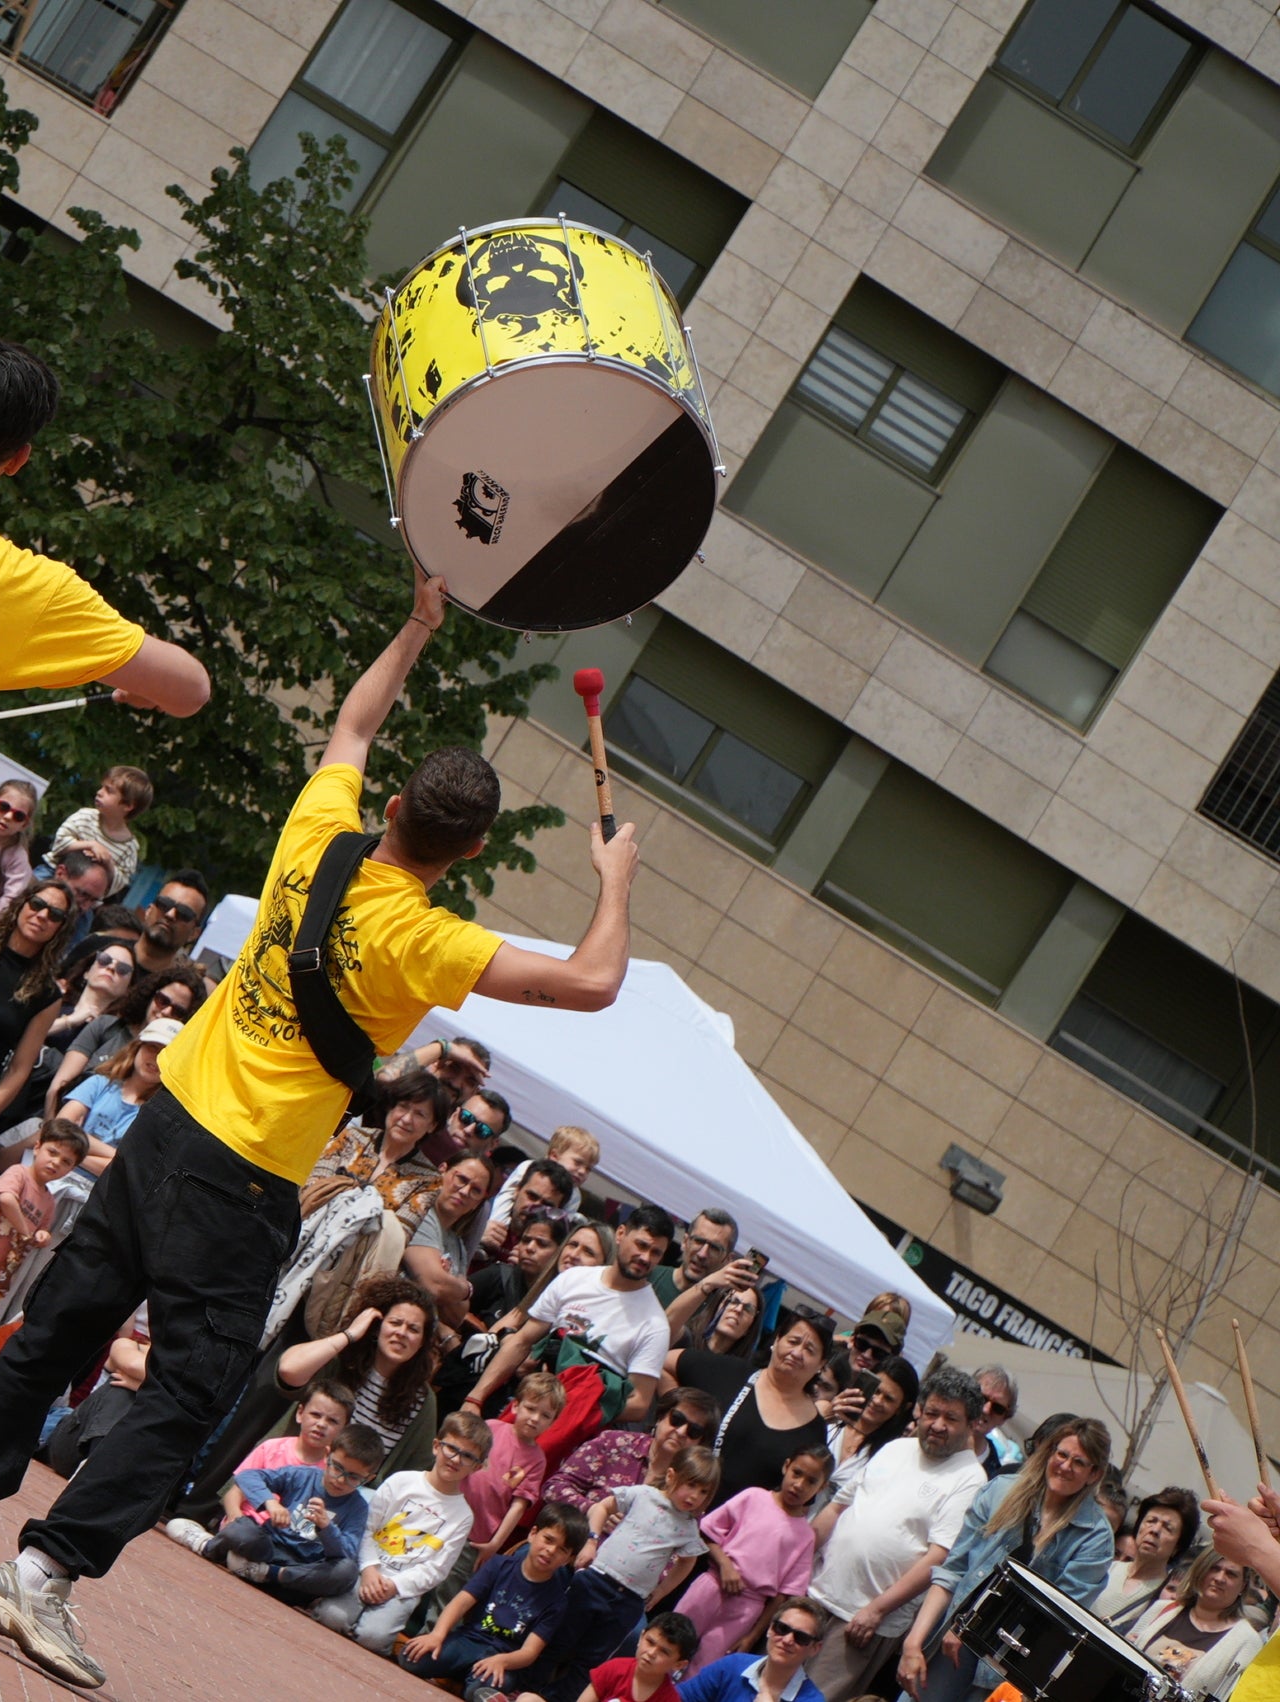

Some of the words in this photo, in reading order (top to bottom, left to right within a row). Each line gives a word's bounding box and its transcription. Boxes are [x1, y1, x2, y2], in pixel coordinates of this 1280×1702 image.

[233, 1007, 270, 1047] TERRASSA
[270, 1022, 301, 1042] NO
[944, 1271, 999, 1319] TACO
